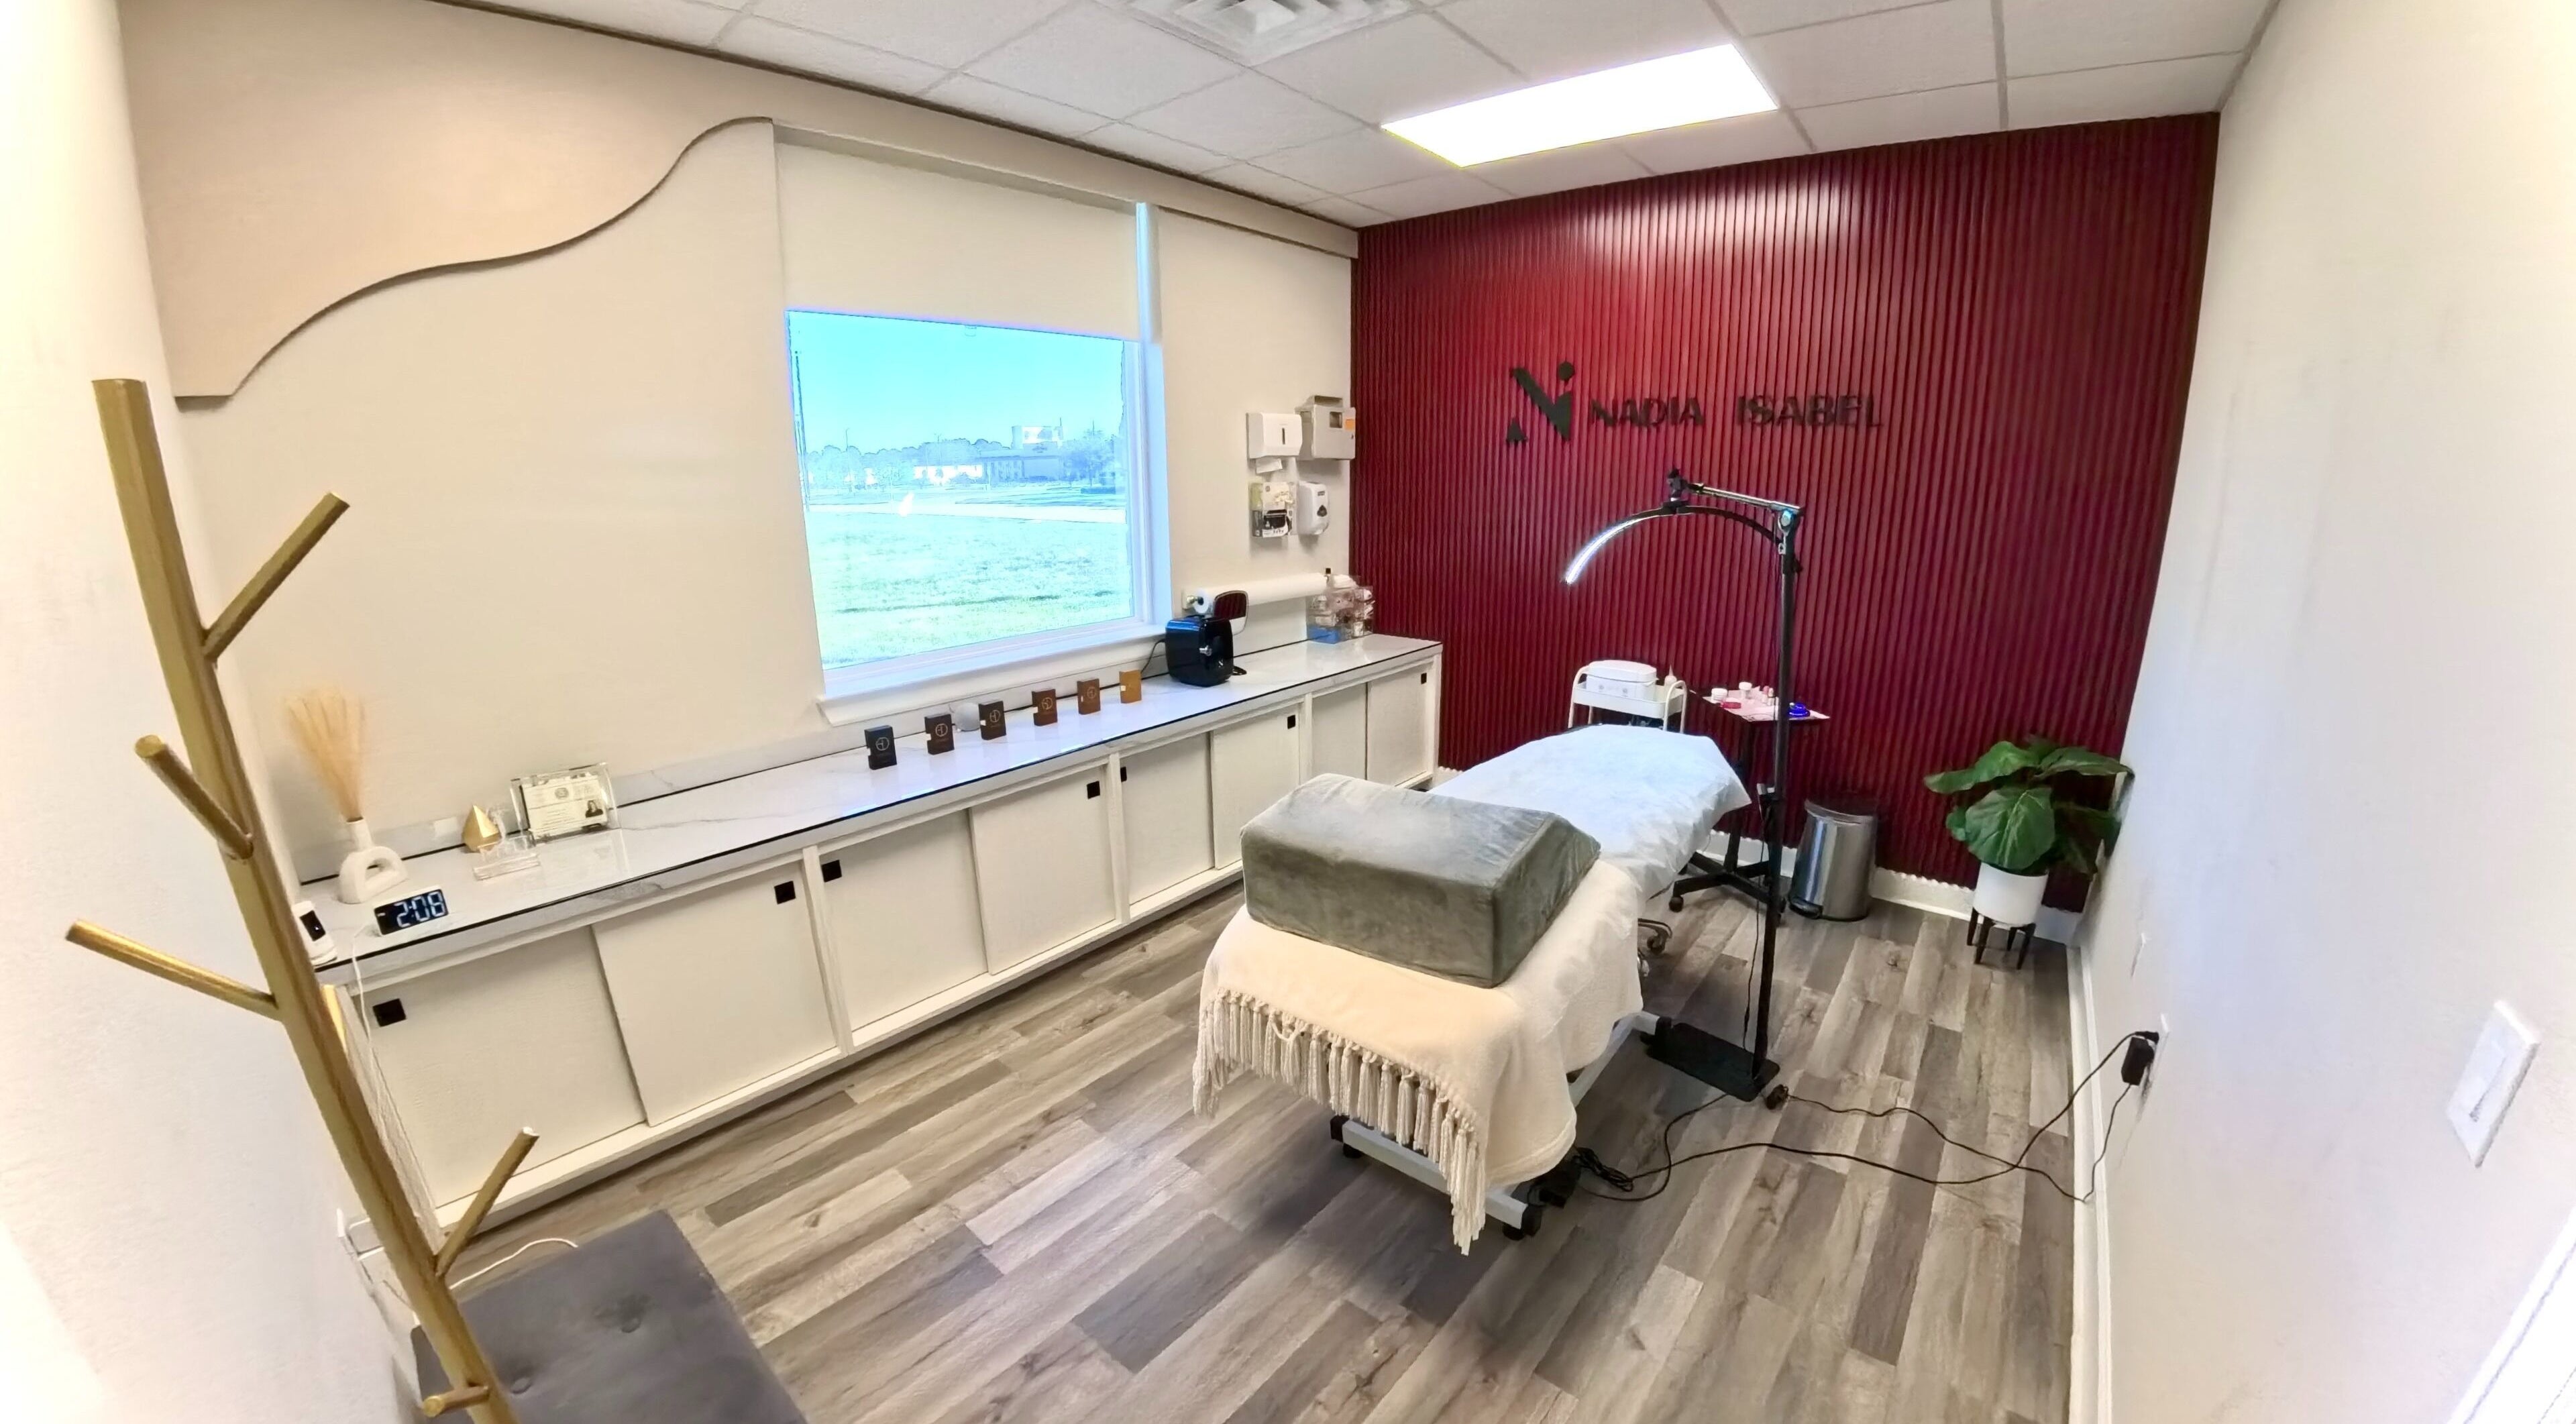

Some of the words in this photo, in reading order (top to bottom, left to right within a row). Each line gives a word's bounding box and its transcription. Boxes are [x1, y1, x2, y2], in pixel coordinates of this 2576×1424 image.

[1591, 396, 1704, 428] NADIA
[1737, 394, 1884, 427] ISABEL
[394, 891, 446, 928] 2:08
